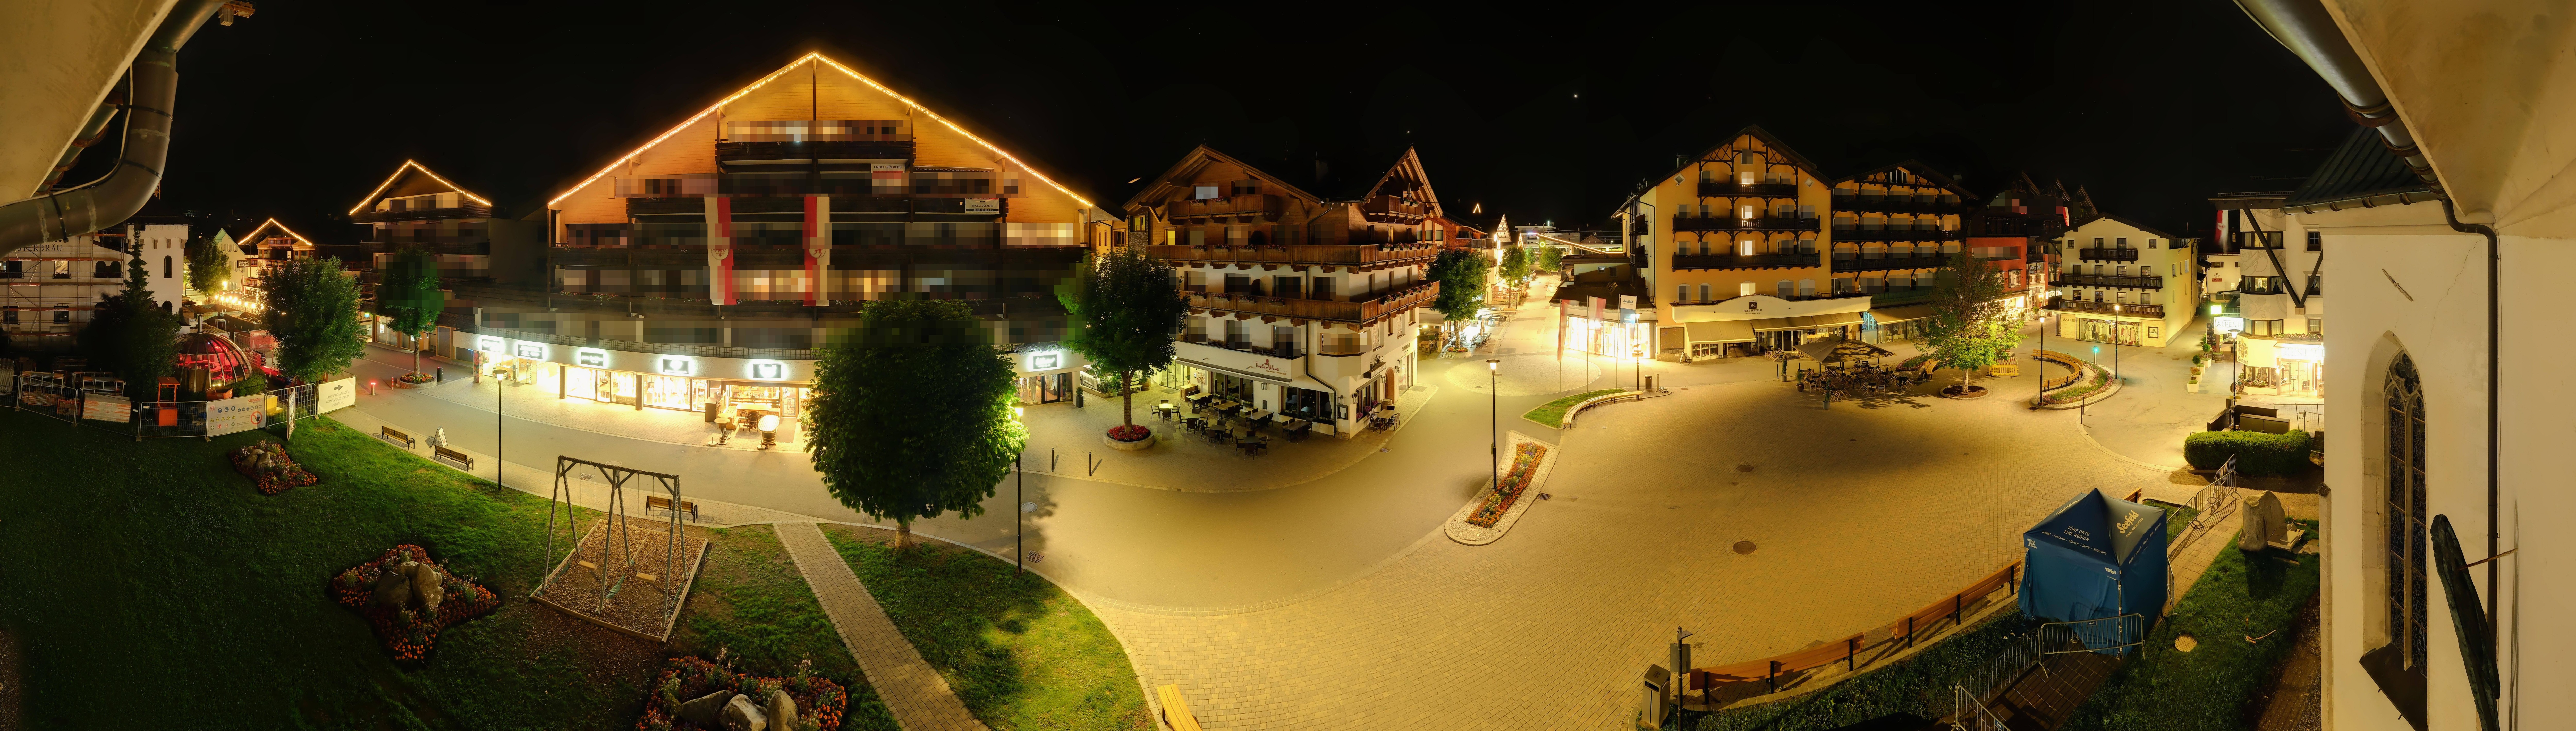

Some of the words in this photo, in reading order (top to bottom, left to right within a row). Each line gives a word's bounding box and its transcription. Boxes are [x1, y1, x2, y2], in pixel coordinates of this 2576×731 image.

[1402, 343, 1411, 351] SAILER
[2238, 355, 2248, 364] Kaltschmid
[1371, 365, 1386, 377] RESTAURANT
[326, 395, 349, 403] KONGRESSZENTRUM
[2117, 509, 2139, 534] Seefeld
[2132, 517, 2143, 530] HOCHPLATEAU
